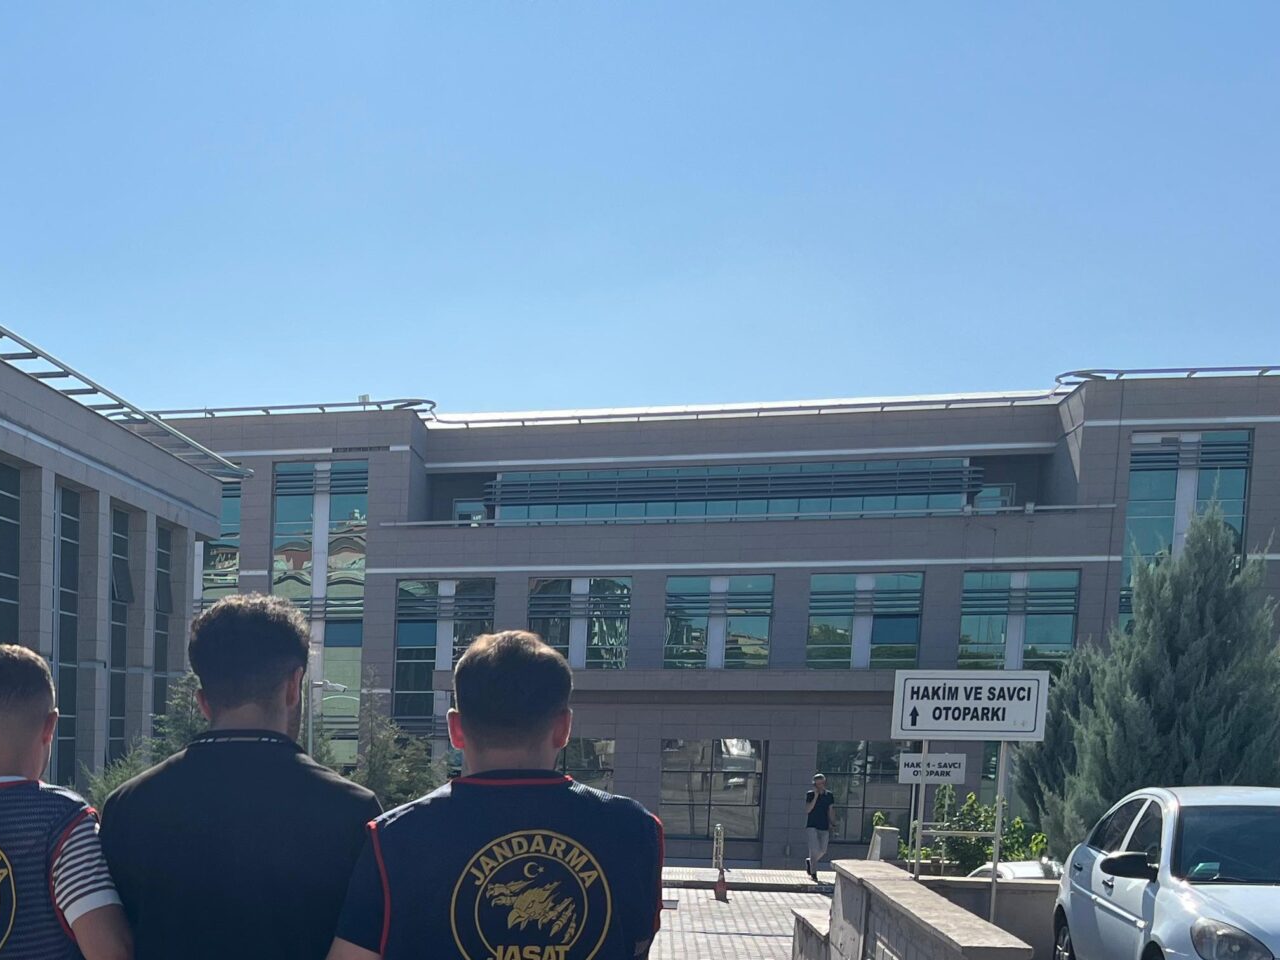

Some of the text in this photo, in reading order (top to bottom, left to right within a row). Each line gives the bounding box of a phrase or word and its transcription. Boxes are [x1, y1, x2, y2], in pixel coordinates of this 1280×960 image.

[910, 683, 1032, 701] HAKİM VE SAVCI
[932, 706, 1006, 721] OTOPARKI
[470, 835, 600, 888] JANDARMA
